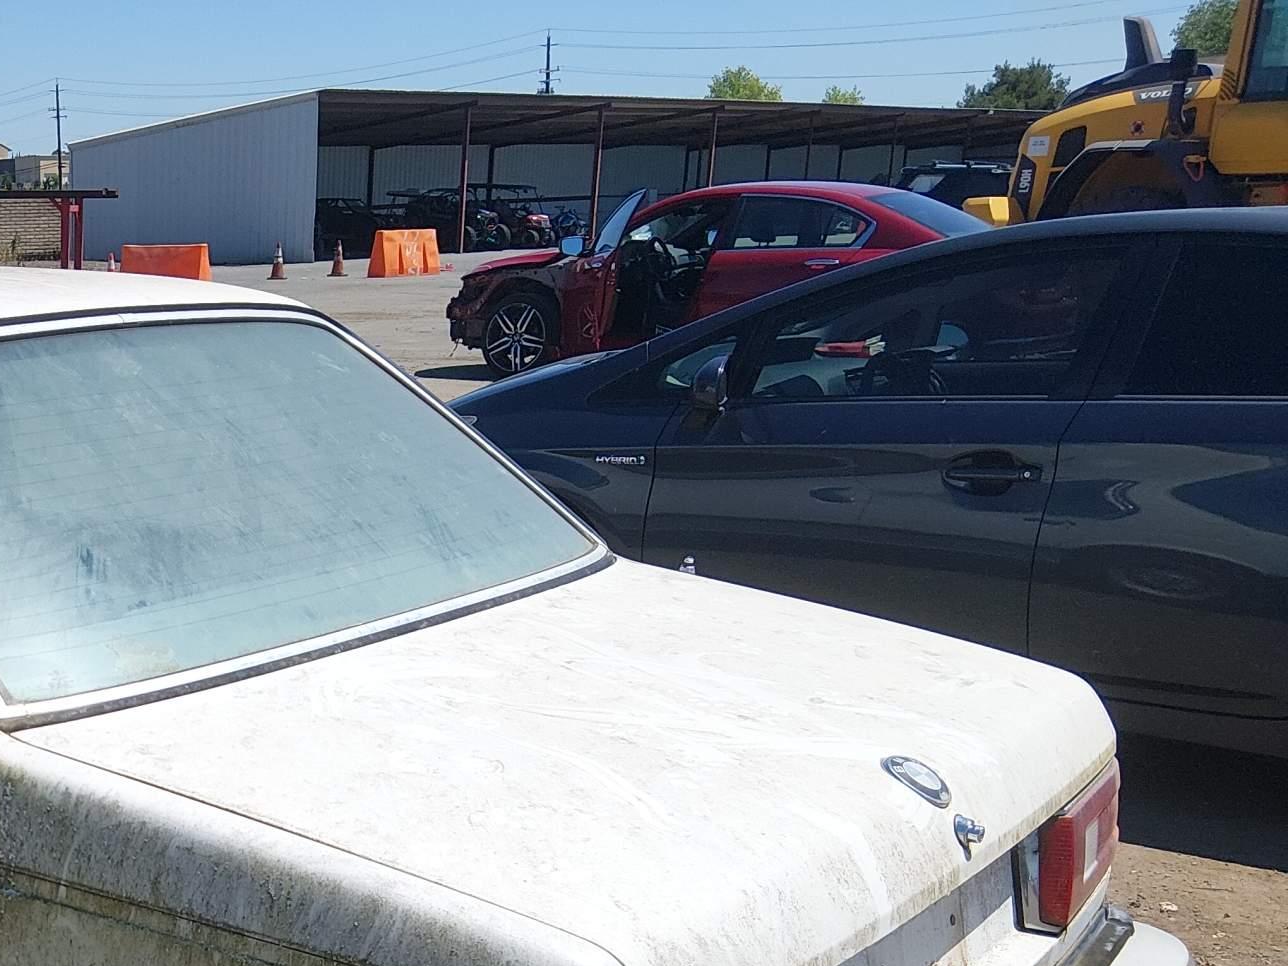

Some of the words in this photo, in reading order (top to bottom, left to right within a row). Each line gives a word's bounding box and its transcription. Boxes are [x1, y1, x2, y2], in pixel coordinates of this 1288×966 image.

[1140, 87, 1193, 99] VOLO
[1018, 169, 1033, 193] L90H
[596, 456, 638, 464] HYBRID
